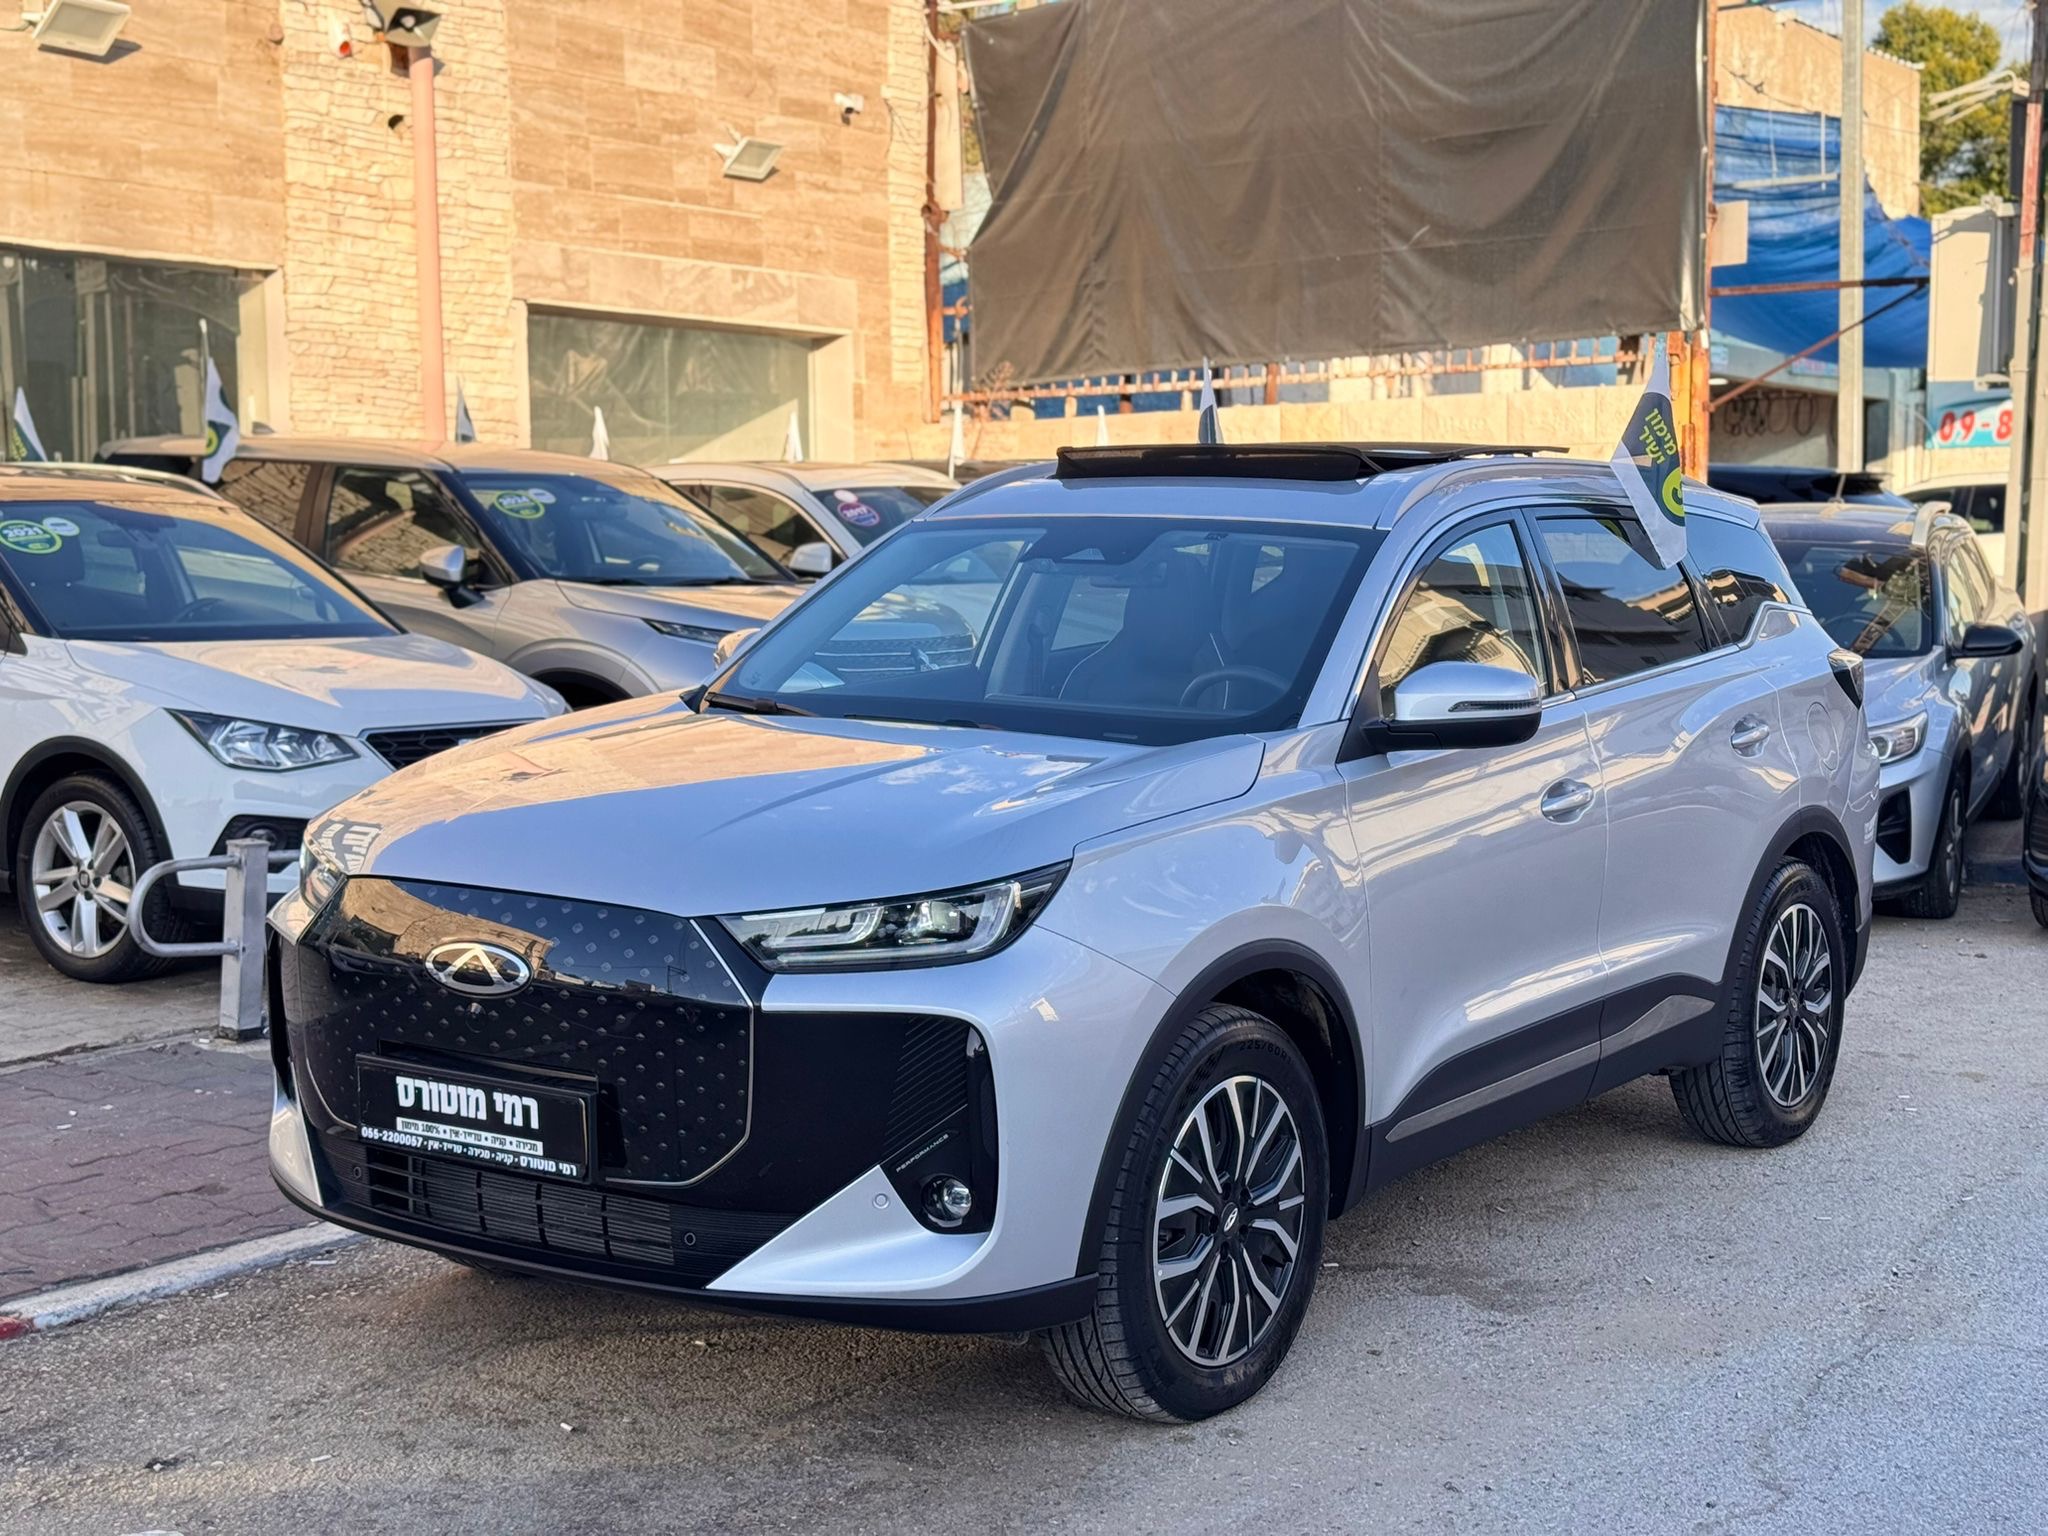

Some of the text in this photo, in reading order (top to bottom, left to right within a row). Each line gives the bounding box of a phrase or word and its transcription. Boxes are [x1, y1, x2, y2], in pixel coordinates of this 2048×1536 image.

[1645, 408, 1677, 456] מימון
[1639, 426, 1666, 464] ישיר
[2, 527, 43, 537] 2021
[396, 1075, 540, 1130] רמי מוטורס
[401, 1120, 420, 1132] מימון
[421, 1123, 441, 1136] 100%
[361, 1127, 577, 1177] רמי מוטורס קניה מכירה טרייד-אין 055-2200057
[491, 1136, 507, 1147] קניה
[516, 1140, 539, 1153] מכירה
[896, 1133, 949, 1173] PERFORMANCE
